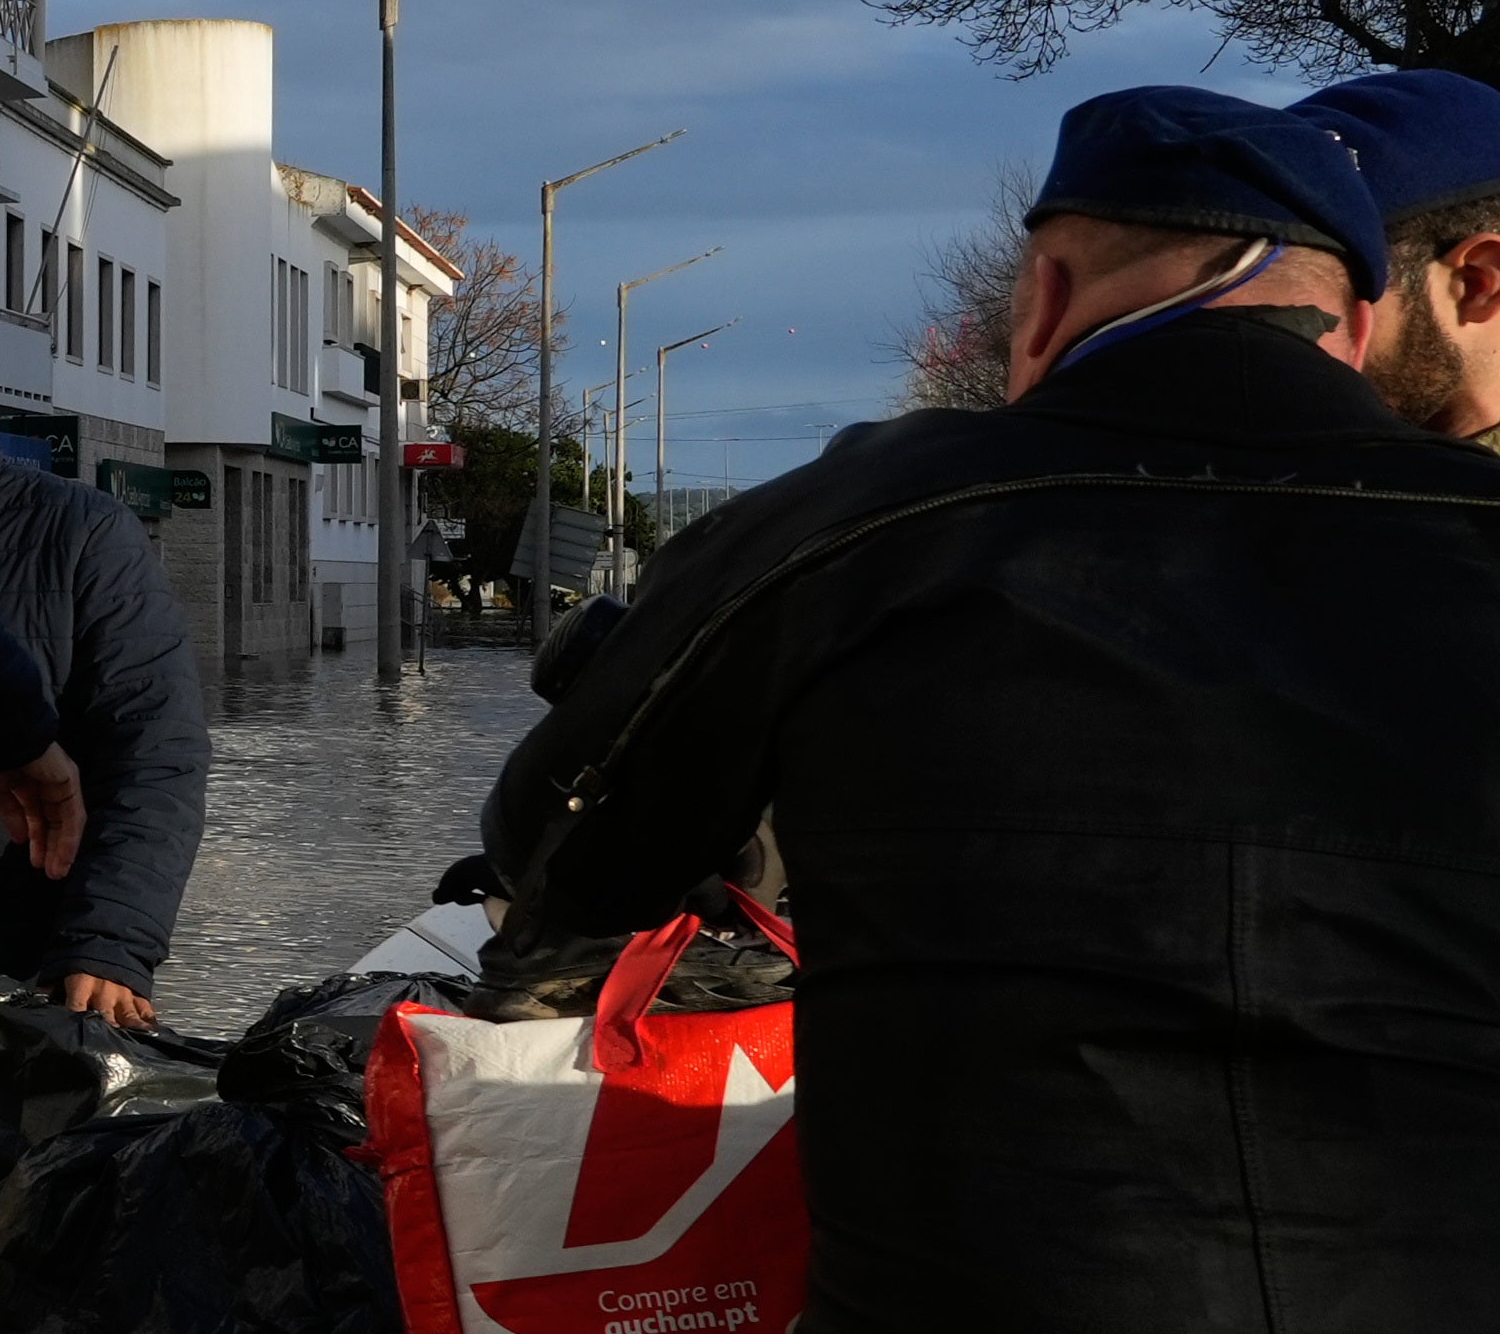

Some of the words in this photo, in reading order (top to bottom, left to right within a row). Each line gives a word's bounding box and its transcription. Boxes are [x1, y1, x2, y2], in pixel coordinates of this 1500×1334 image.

[339, 436, 359, 448] CA
[173, 476, 207, 487] Balcão
[174, 492, 193, 504] 24
[597, 1284, 708, 1317] Compre
[713, 1278, 757, 1302] em
